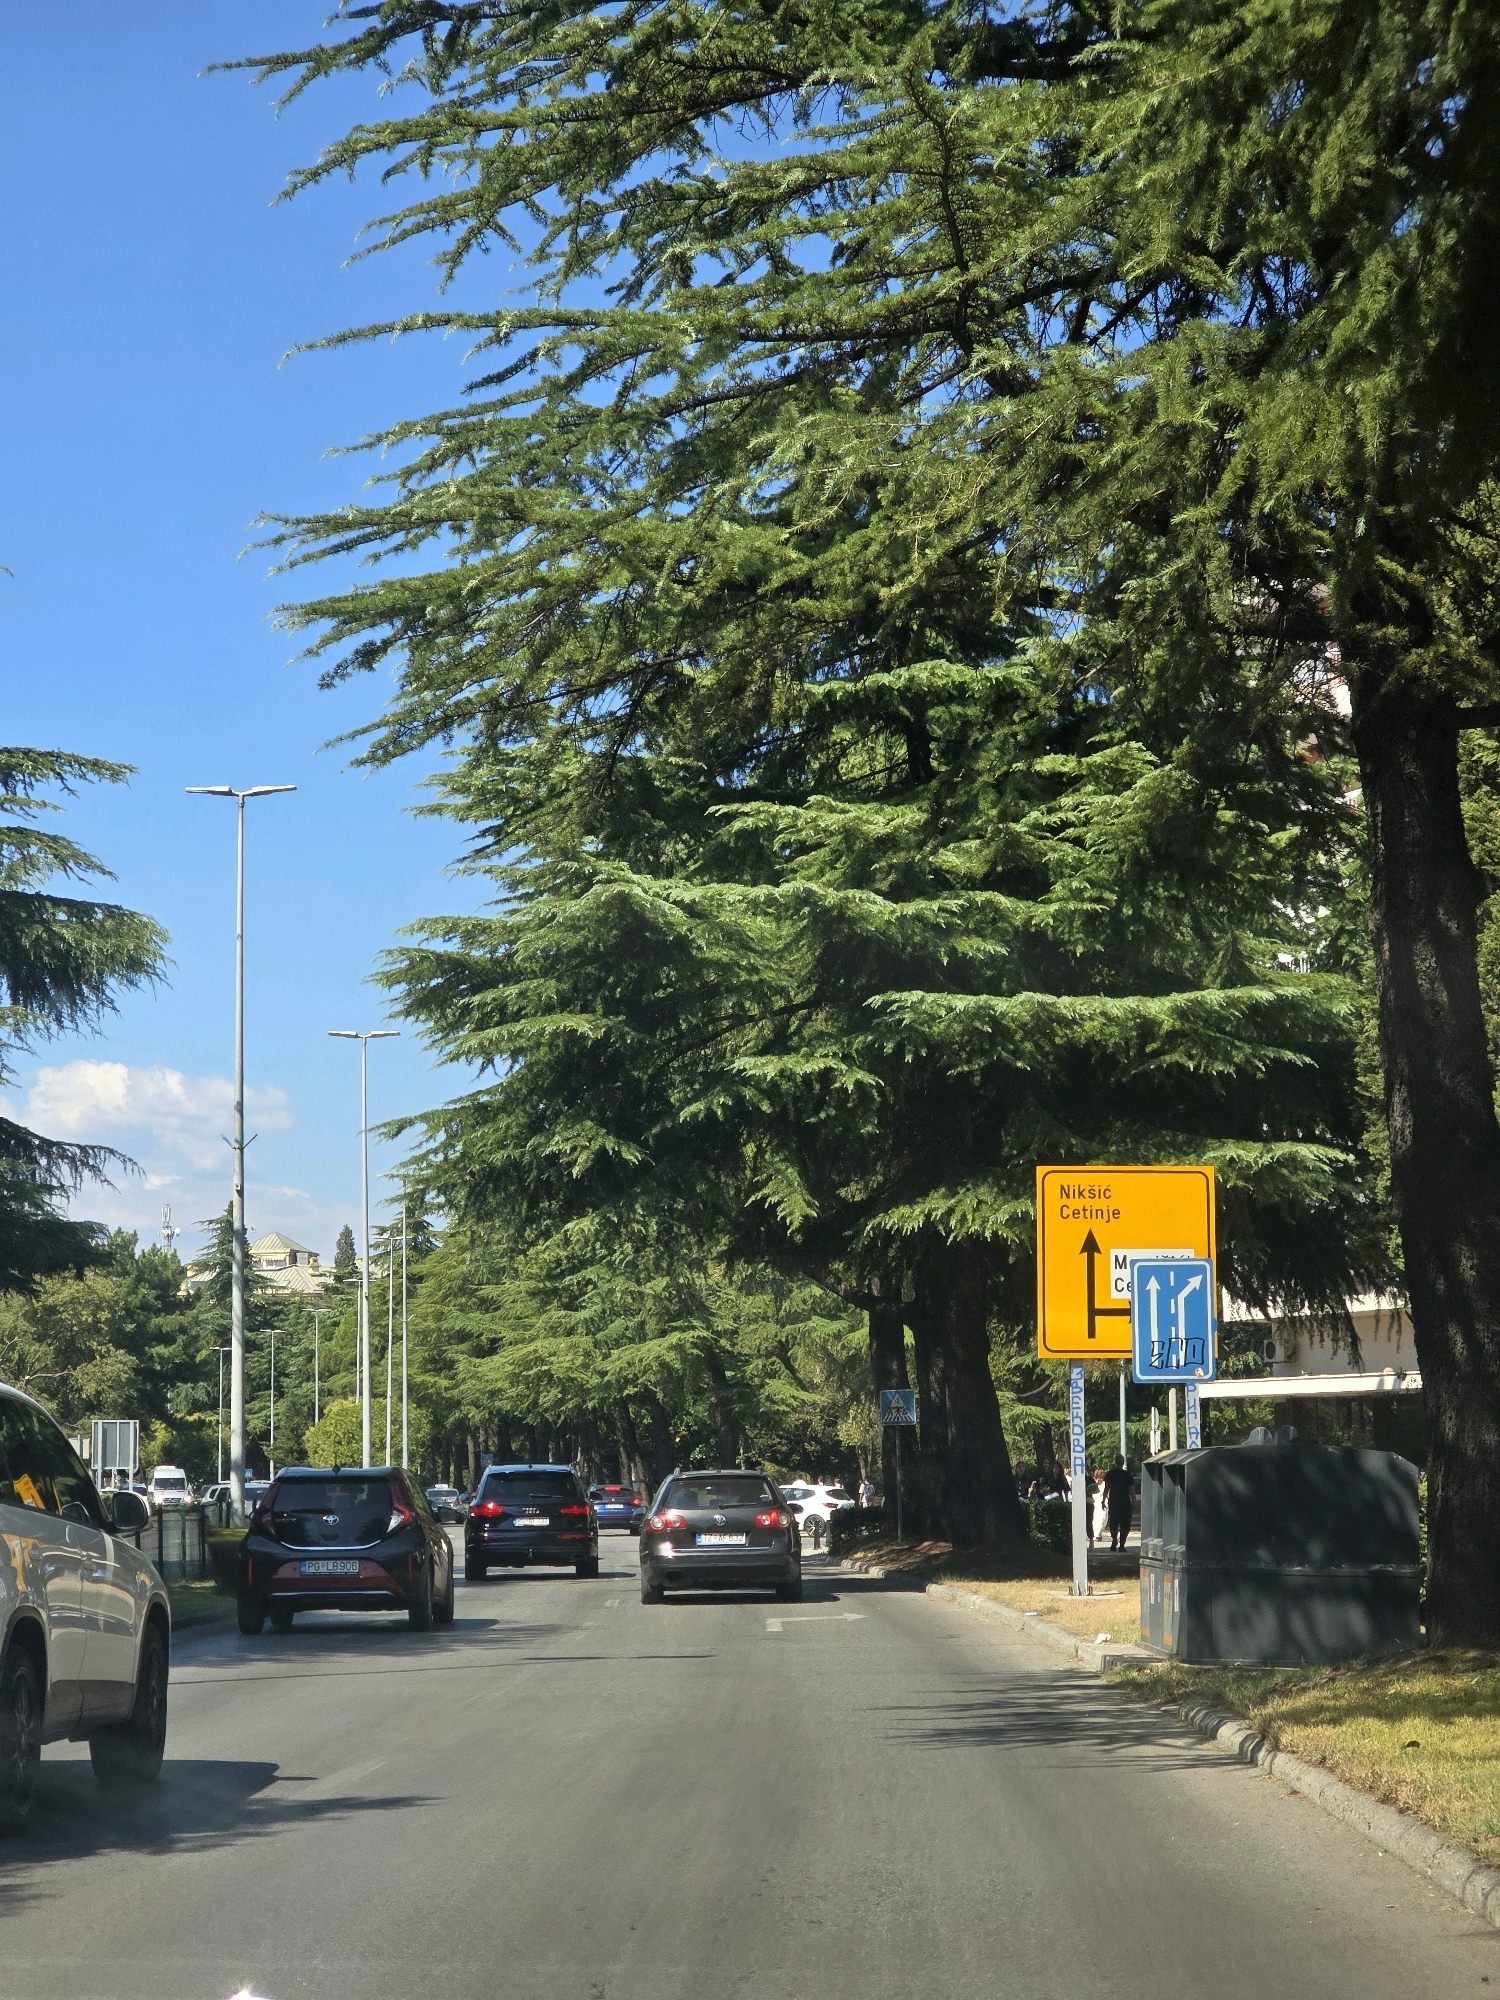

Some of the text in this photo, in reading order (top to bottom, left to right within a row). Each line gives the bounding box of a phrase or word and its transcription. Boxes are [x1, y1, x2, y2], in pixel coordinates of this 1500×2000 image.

[1060, 1184, 1112, 1200] Nikšić
[1060, 1204, 1121, 1224] Cetinje
[307, 1561, 320, 1571] PG
